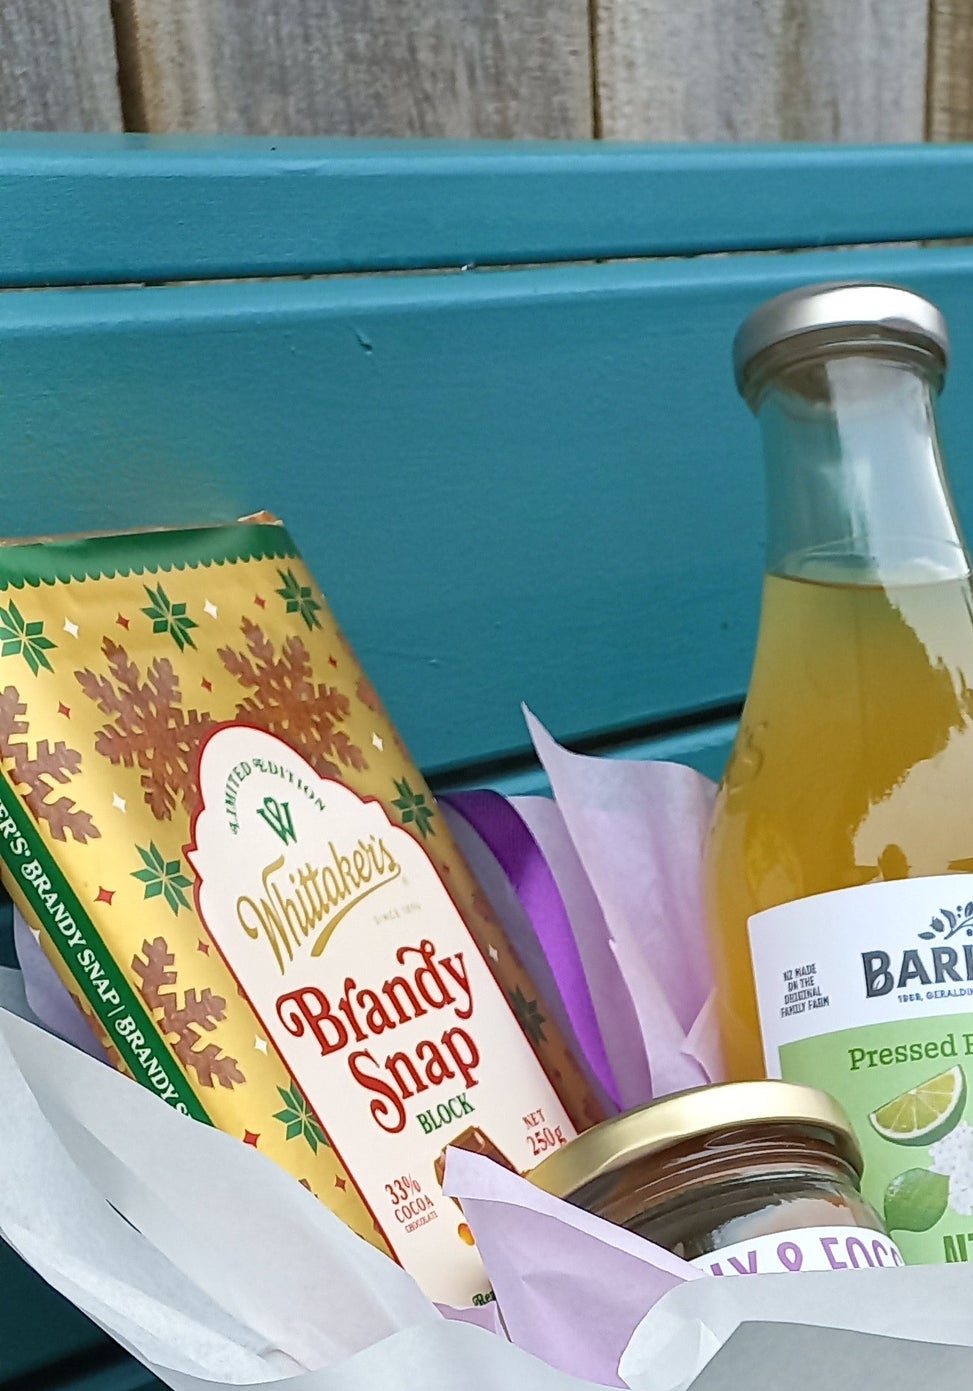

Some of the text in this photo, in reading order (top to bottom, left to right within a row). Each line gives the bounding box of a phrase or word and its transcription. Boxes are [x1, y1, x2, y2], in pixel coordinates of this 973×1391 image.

[225, 758, 326, 835] LIMITED EDITION
[236, 834, 401, 976] Whittaker's
[21, 859, 87, 949] BRANDY
[77, 948, 121, 1002] SNAP
[115, 1013, 179, 1101] BRANDY
[275, 939, 474, 1057] Brandy
[800, 976, 815, 988] THE
[849, 1033, 958, 1071] Pressed
[348, 1026, 481, 1134] Snap
[416, 1092, 476, 1135] BLOCK
[522, 1108, 546, 1130] NET
[526, 1124, 568, 1156] 250g
[385, 1173, 422, 1205] 33%
[394, 1194, 435, 1224] COCOA
